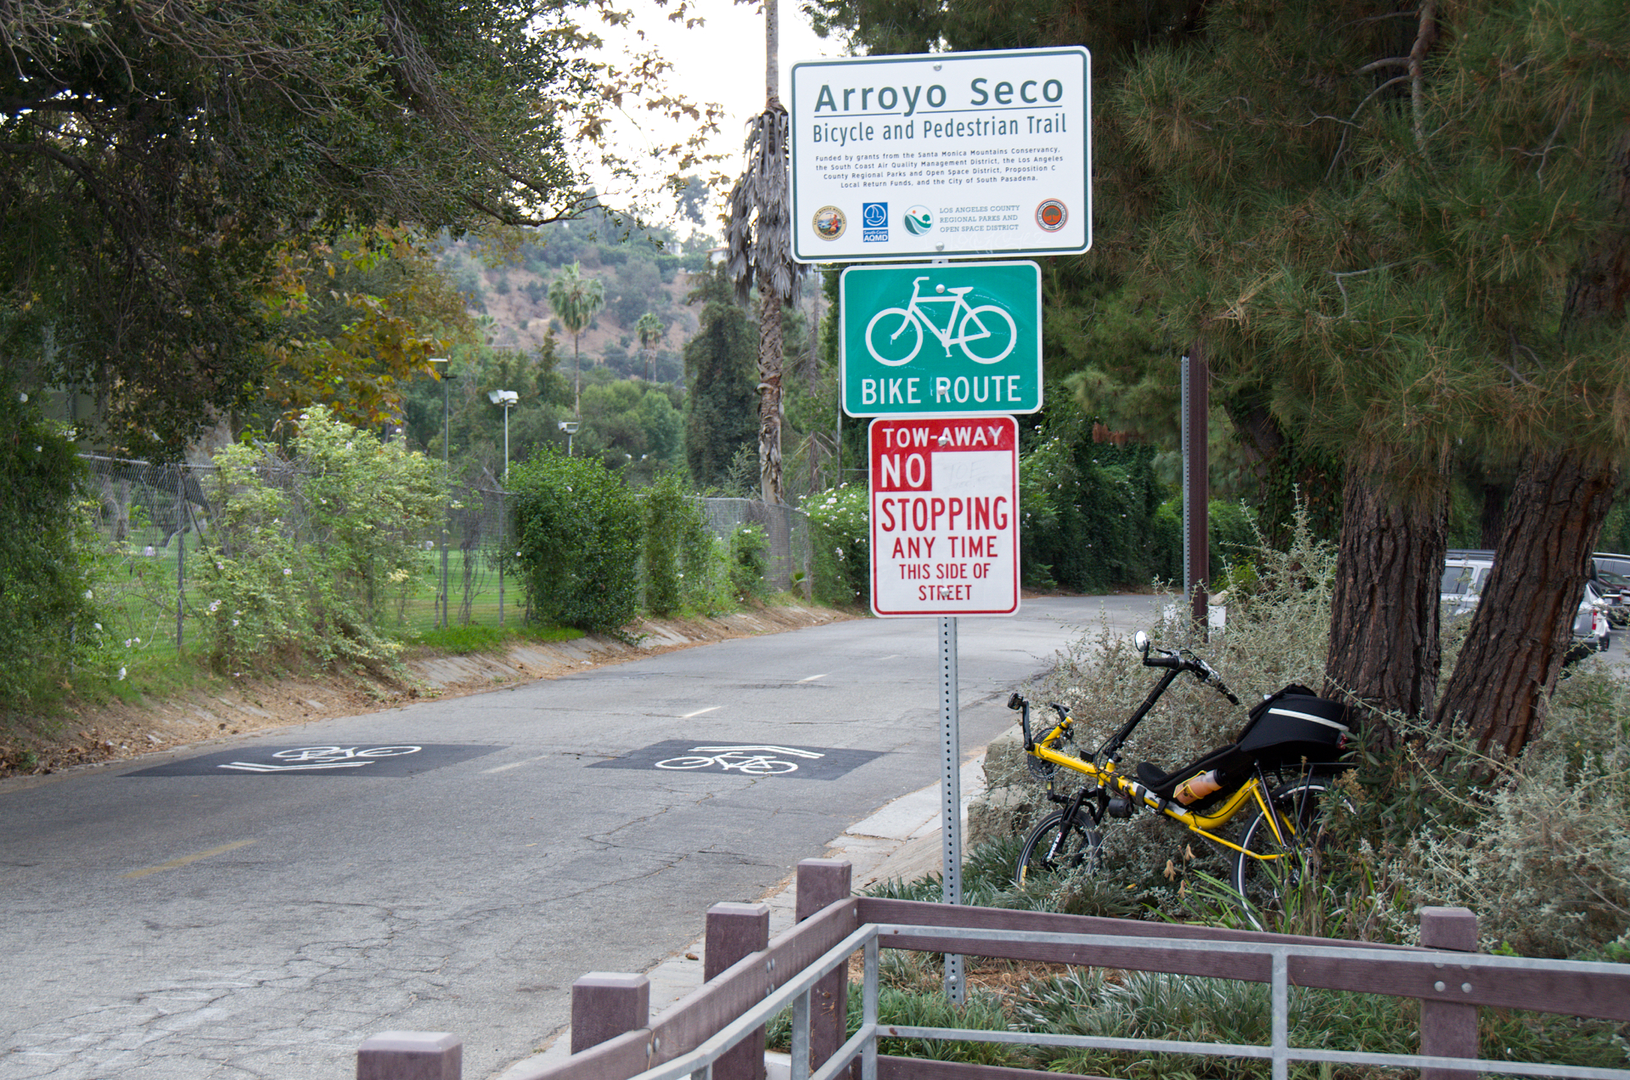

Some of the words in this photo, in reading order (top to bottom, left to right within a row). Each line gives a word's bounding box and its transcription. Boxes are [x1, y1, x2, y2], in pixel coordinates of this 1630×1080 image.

[814, 84, 947, 117] Arroyo
[970, 78, 1063, 106] Seco
[813, 122, 874, 147] Bicycle
[883, 122, 914, 140] and
[924, 116, 1018, 138] Pedestrian
[1027, 113, 1067, 134] Trail
[856, 153, 880, 161] grants
[970, 148, 1008, 156] Mountains
[1011, 146, 1060, 155] Conservancy,
[921, 160, 967, 168] Management
[1034, 155, 1063, 163] Angeles
[852, 171, 884, 180] Regional
[948, 168, 969, 176] Space
[1005, 165, 1048, 173] Proposition
[862, 378, 921, 405] BIKE
[935, 375, 1022, 404] ROUTE
[882, 426, 1004, 448] TOW-AWAY
[881, 453, 926, 488] NO
[881, 495, 1008, 533] STOPPING
[892, 536, 935, 559] ANY
[948, 535, 998, 558] TIME
[899, 563, 930, 580] THIS
[936, 563, 968, 579] SIDE
[973, 562, 991, 579] OF
[918, 585, 972, 601] STREET
